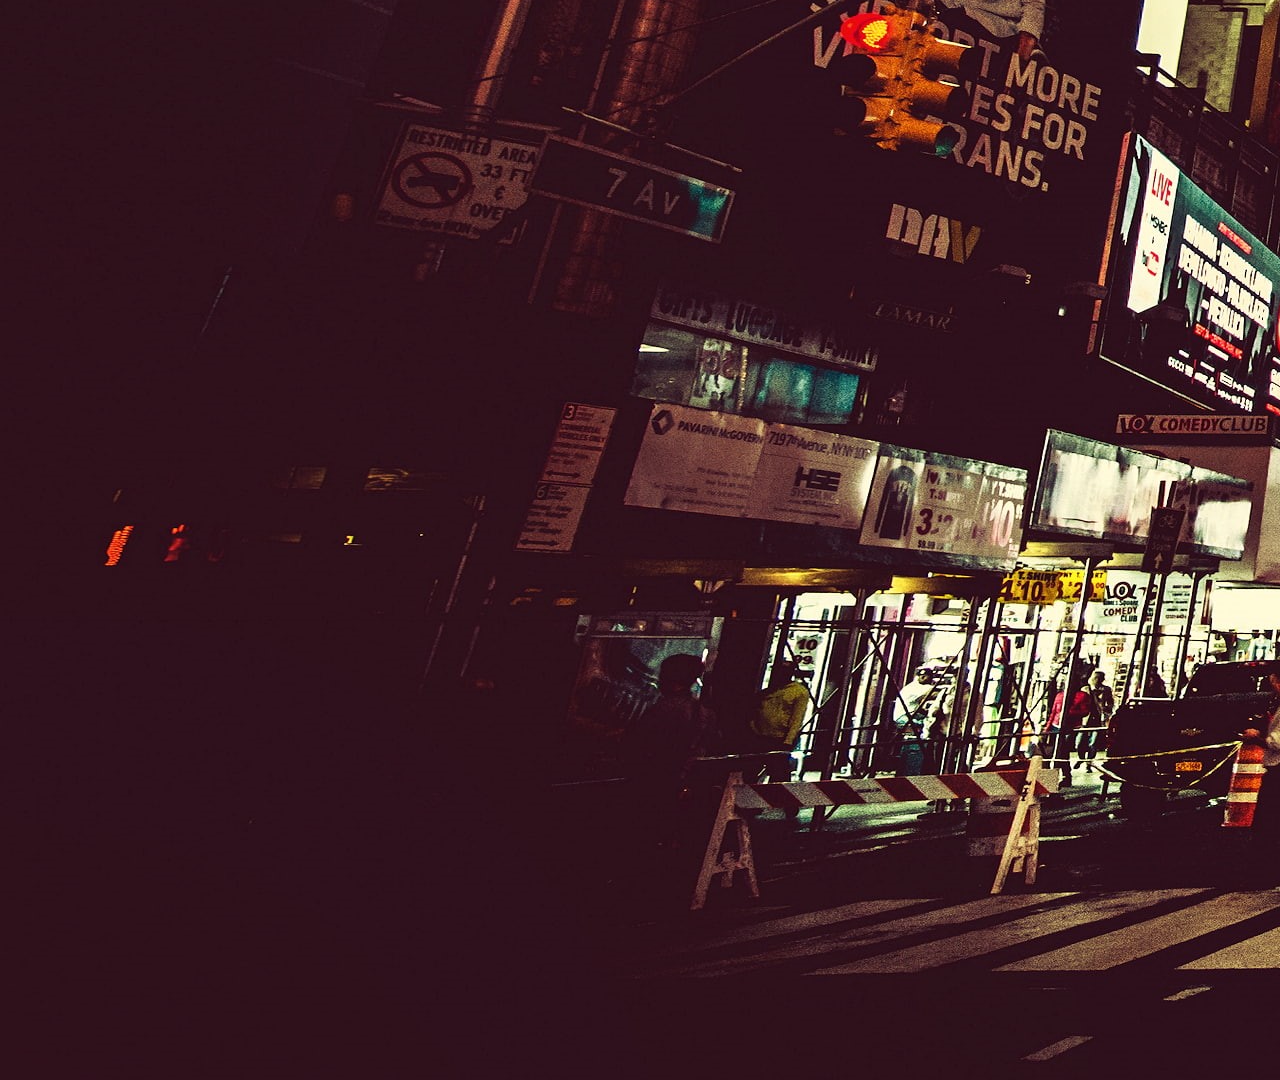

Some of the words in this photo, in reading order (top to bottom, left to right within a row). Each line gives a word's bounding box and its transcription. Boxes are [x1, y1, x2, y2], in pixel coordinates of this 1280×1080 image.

[1005, 50, 1103, 122] MORE
[408, 129, 491, 156] RESTRICTED
[498, 147, 537, 165] AREA
[1021, 105, 1088, 161] FOR
[480, 164, 503, 179] 33
[509, 169, 532, 183] FT
[1151, 168, 1173, 206] LIVE
[605, 167, 628, 199] 7
[633, 178, 680, 216] Av
[885, 202, 982, 264] DAV
[564, 405, 576, 419] 3
[677, 421, 718, 437] PAVARINI
[536, 485, 546, 499] 6
[916, 508, 934, 535] 3
[1103, 606, 1138, 617] COMEDY
